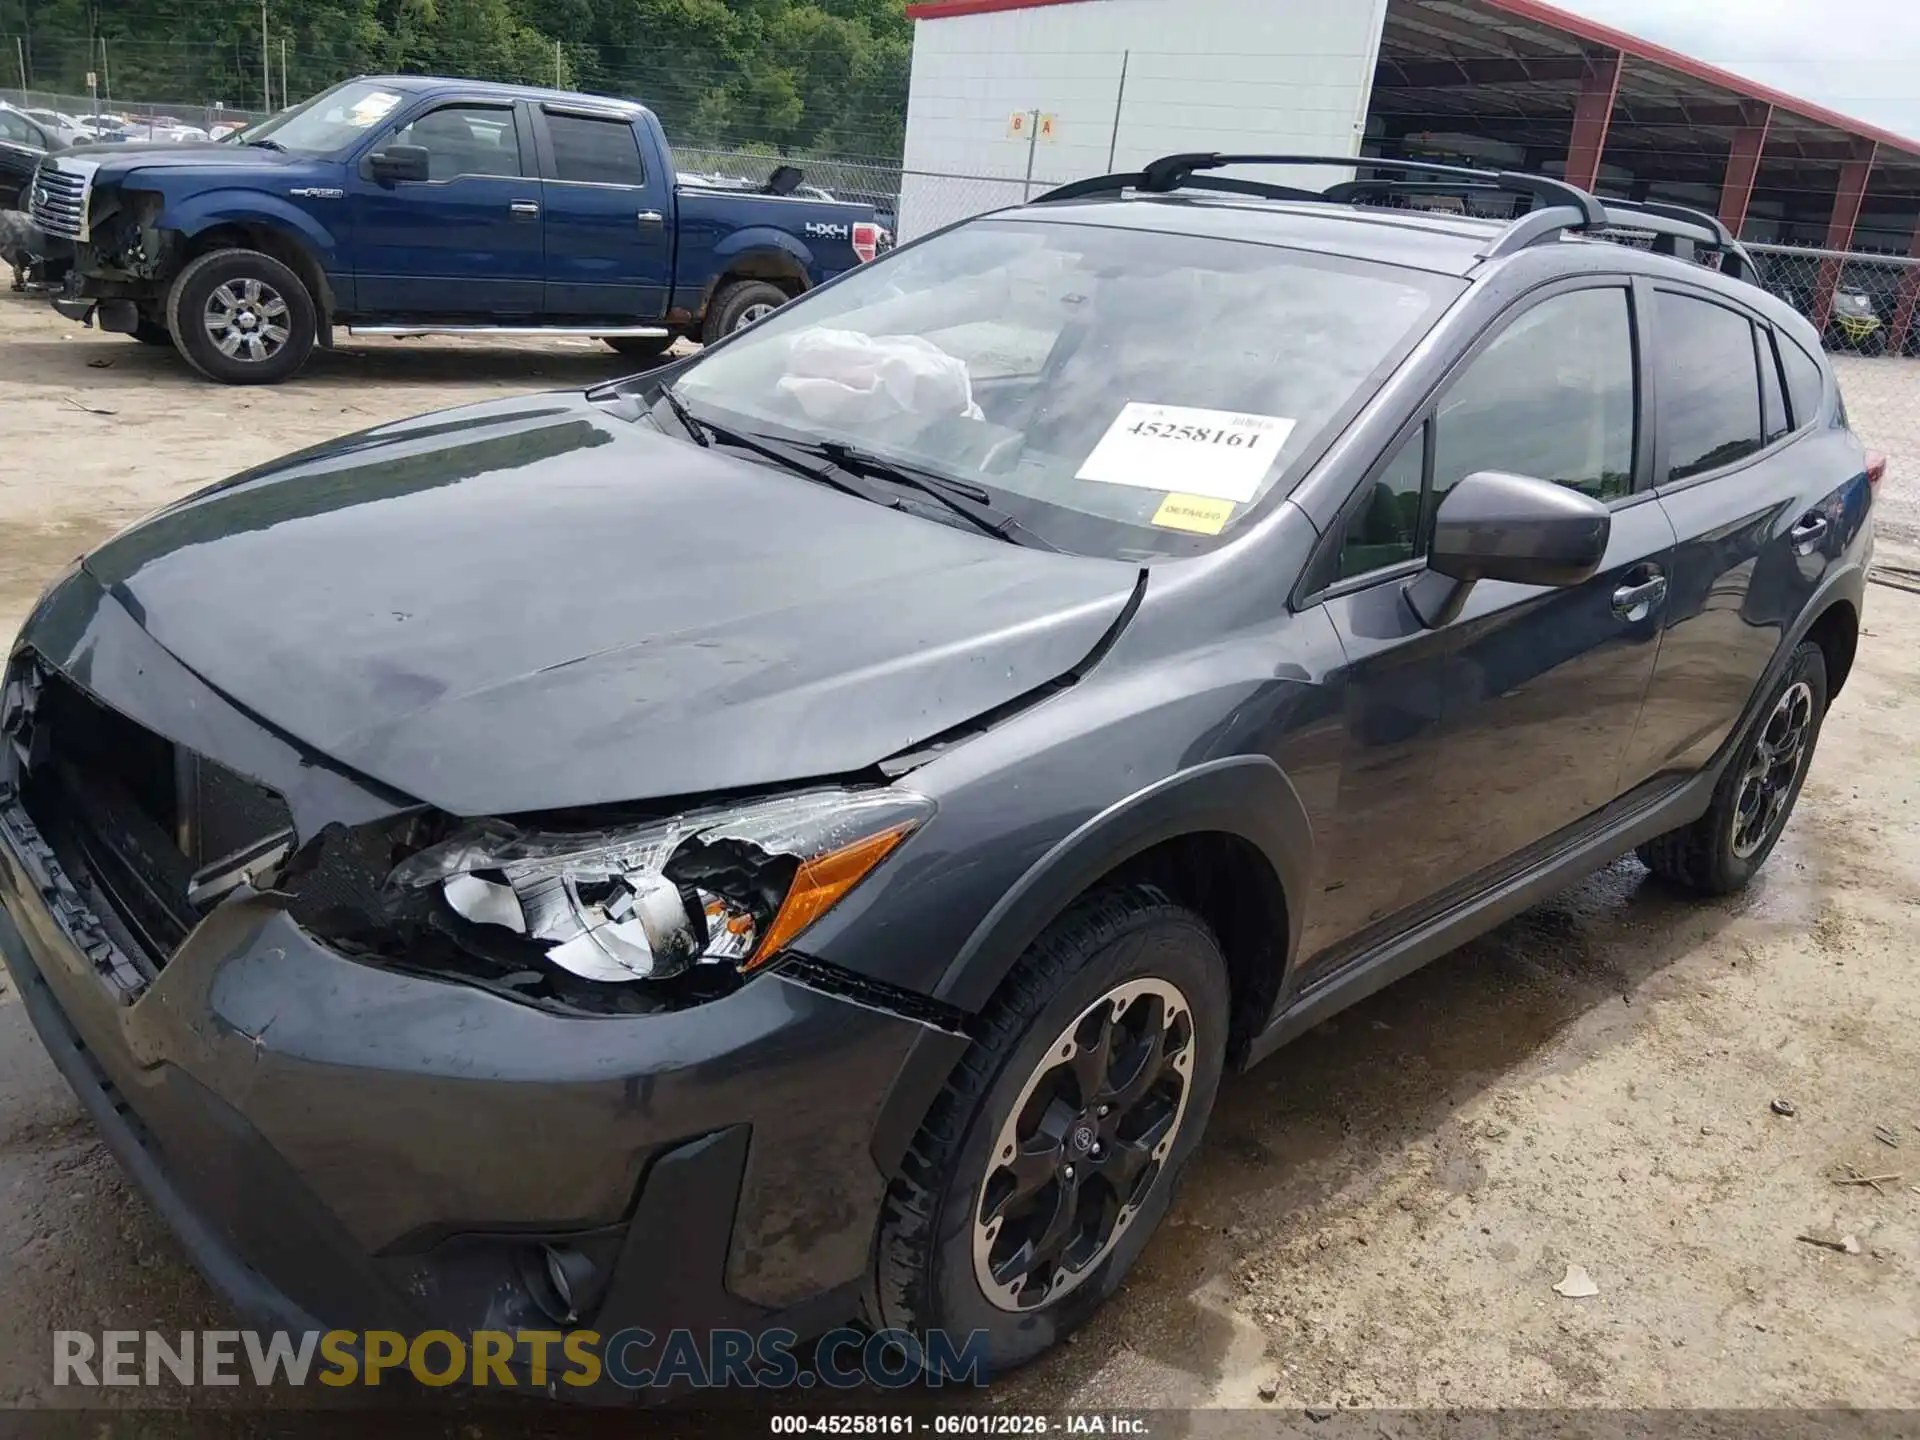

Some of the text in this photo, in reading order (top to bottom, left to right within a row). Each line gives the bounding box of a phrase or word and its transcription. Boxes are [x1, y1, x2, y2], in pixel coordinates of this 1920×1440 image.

[1014, 118, 1022, 130] B
[1042, 121, 1050, 133] A
[805, 222, 848, 237] 4X4
[1127, 420, 1260, 449] 45258161
